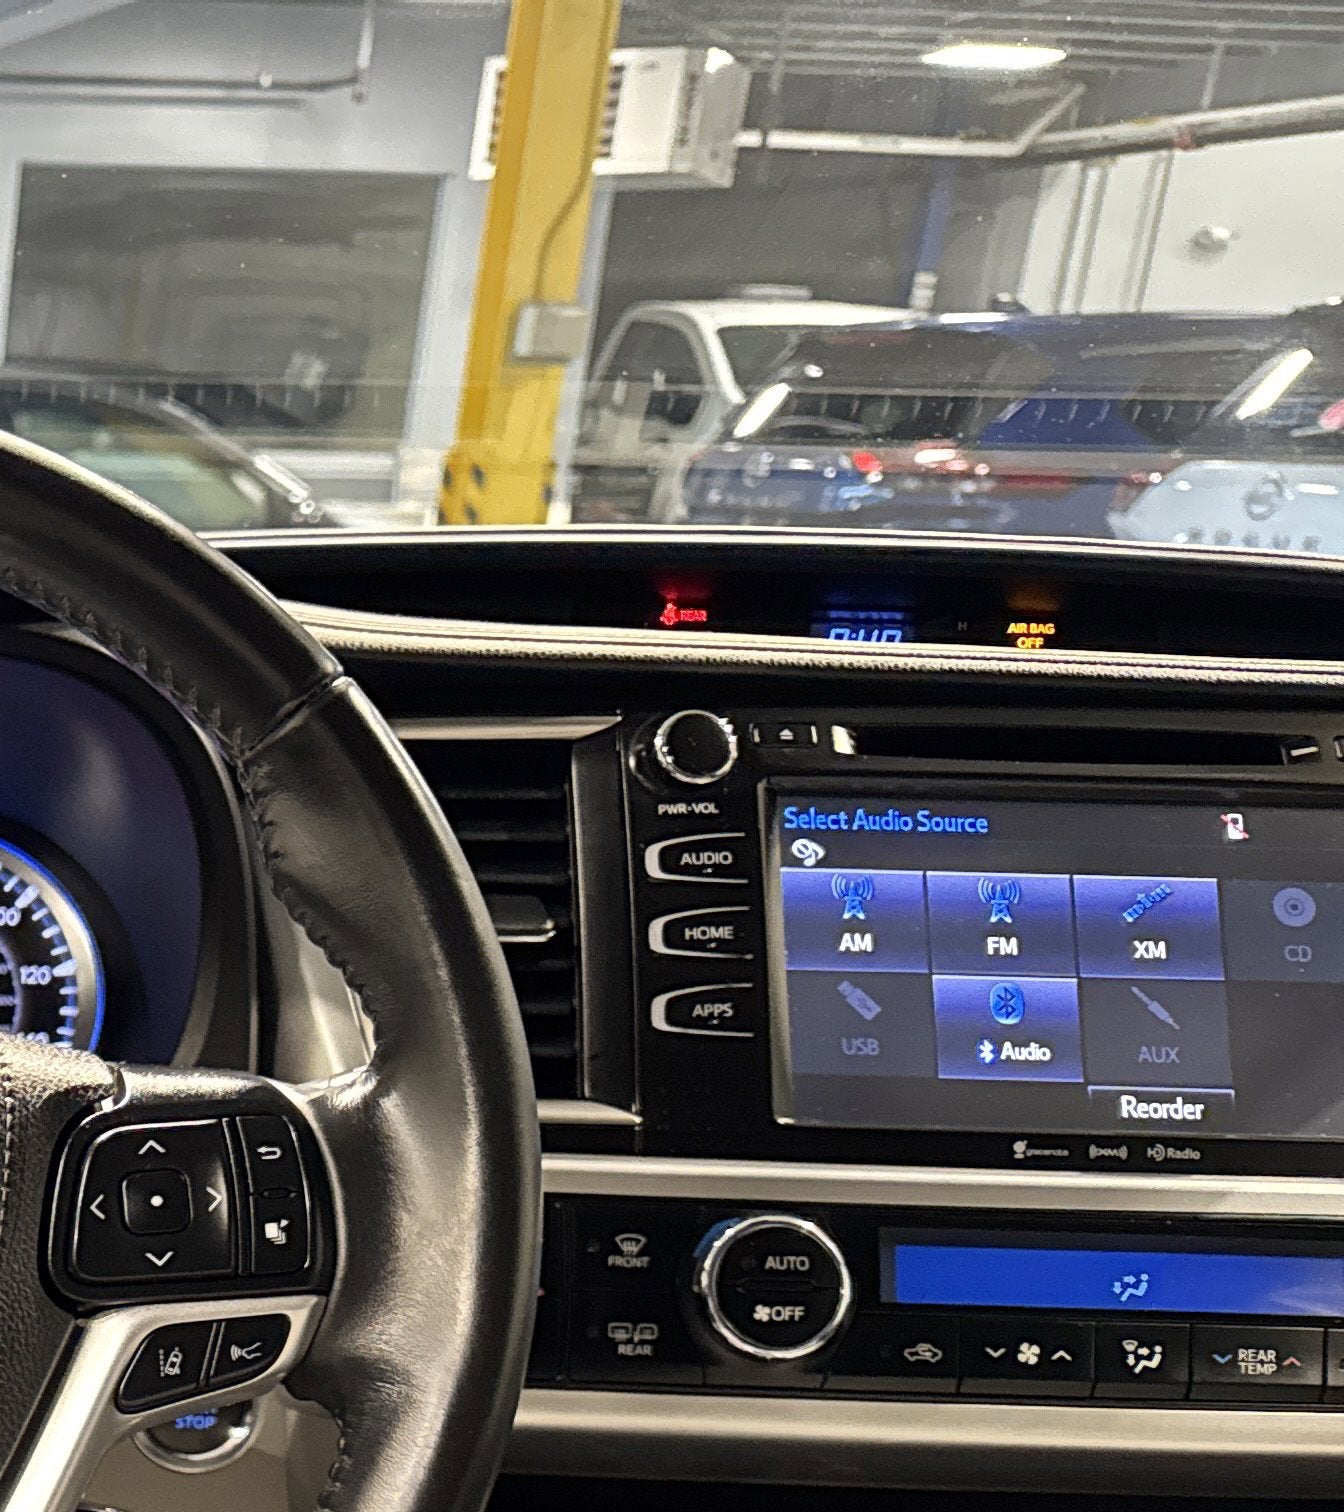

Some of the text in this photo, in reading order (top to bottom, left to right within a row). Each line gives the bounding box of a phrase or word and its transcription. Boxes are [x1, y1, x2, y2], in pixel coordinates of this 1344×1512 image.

[680, 609, 708, 622] REAR
[1006, 622, 1056, 635] AIR BAG
[1016, 636, 1044, 649] OFF
[783, 805, 989, 834] Select Audio Source
[679, 850, 733, 866] AUDIO
[684, 925, 735, 941] HOME
[838, 932, 874, 953] AM
[986, 935, 1019, 956] FM
[1132, 940, 1168, 961] XM
[1284, 944, 1312, 963] CD
[19, 964, 53, 986] 120
[691, 1002, 734, 1018] APPS
[841, 1037, 880, 1056] USB
[1000, 1041, 1052, 1063] Audio
[1138, 1046, 1181, 1065] AUX
[1119, 1094, 1205, 1121] Reorder
[1166, 1147, 1201, 1160] Radio
[607, 1255, 651, 1269] FRONT
[764, 1255, 811, 1272] AUTO
[771, 1305, 806, 1322] OFF
[617, 1343, 654, 1357] REAR
[1237, 1348, 1277, 1363] REAR
[1237, 1361, 1278, 1375] TEMP
[175, 1413, 218, 1430] STOP
